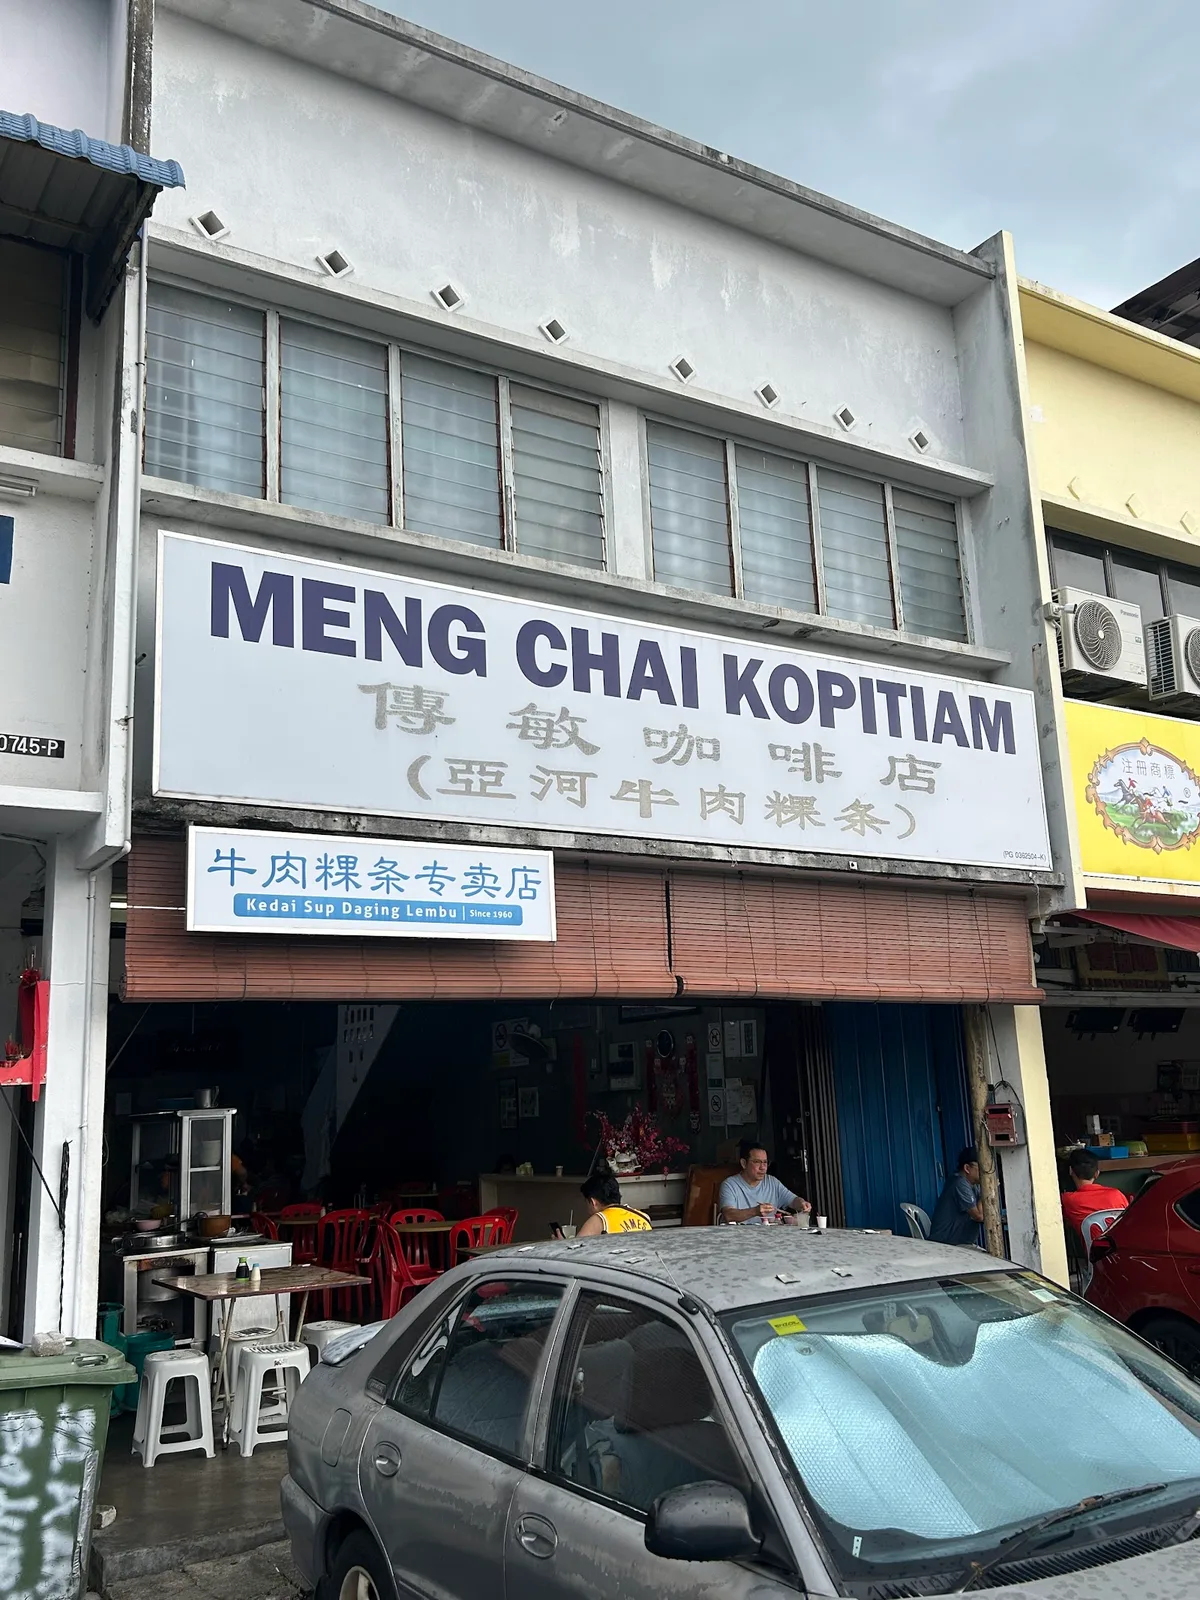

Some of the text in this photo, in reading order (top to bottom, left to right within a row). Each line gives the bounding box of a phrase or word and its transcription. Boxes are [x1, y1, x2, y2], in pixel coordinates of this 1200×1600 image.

[210, 561, 1016, 755] MENG CHAI KOPITIAM
[357, 681, 942, 795] 傳敏咖啡店
[207, 847, 542, 900] 牛肉粿条专卖店
[246, 898, 513, 919] Kedai Sup Daging Lembu Since 1960
[619, 1218, 648, 1232] JAMES
